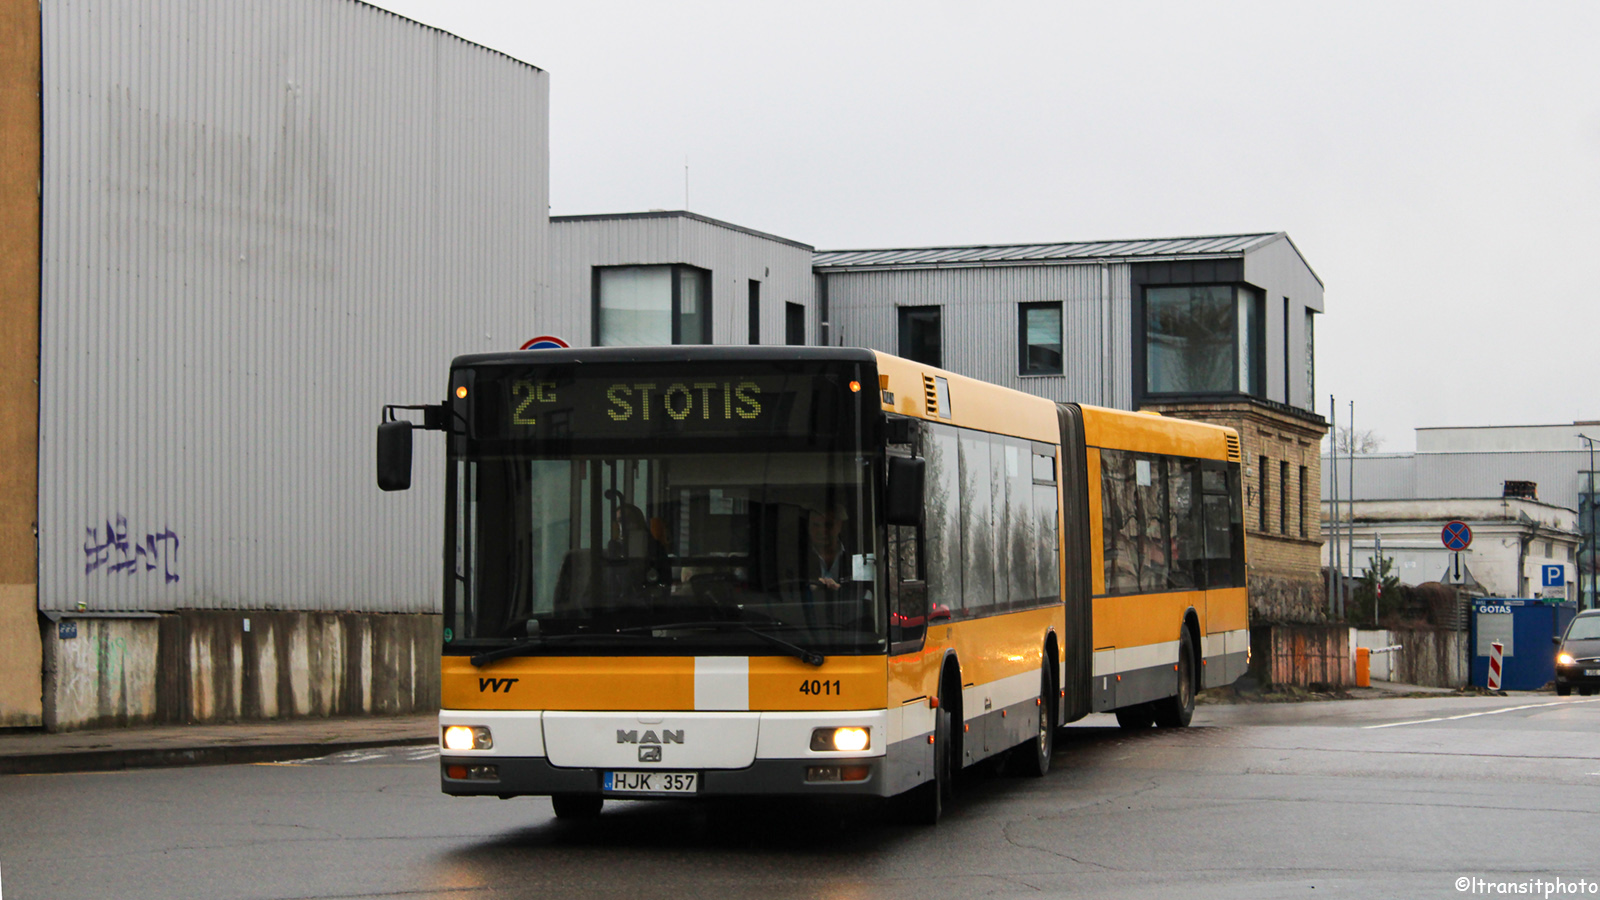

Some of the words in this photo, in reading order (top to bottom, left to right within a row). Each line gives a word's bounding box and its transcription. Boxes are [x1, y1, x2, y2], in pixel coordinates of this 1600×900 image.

[512, 379, 556, 425] 2G
[606, 381, 762, 421] STOTIS
[1547, 566, 1561, 585] P
[1479, 605, 1512, 614] GOTAS
[479, 678, 519, 693] VVT
[799, 680, 842, 696] 4011
[616, 729, 685, 744] MAN
[614, 773, 652, 790] HJK
[663, 774, 695, 791] 357
